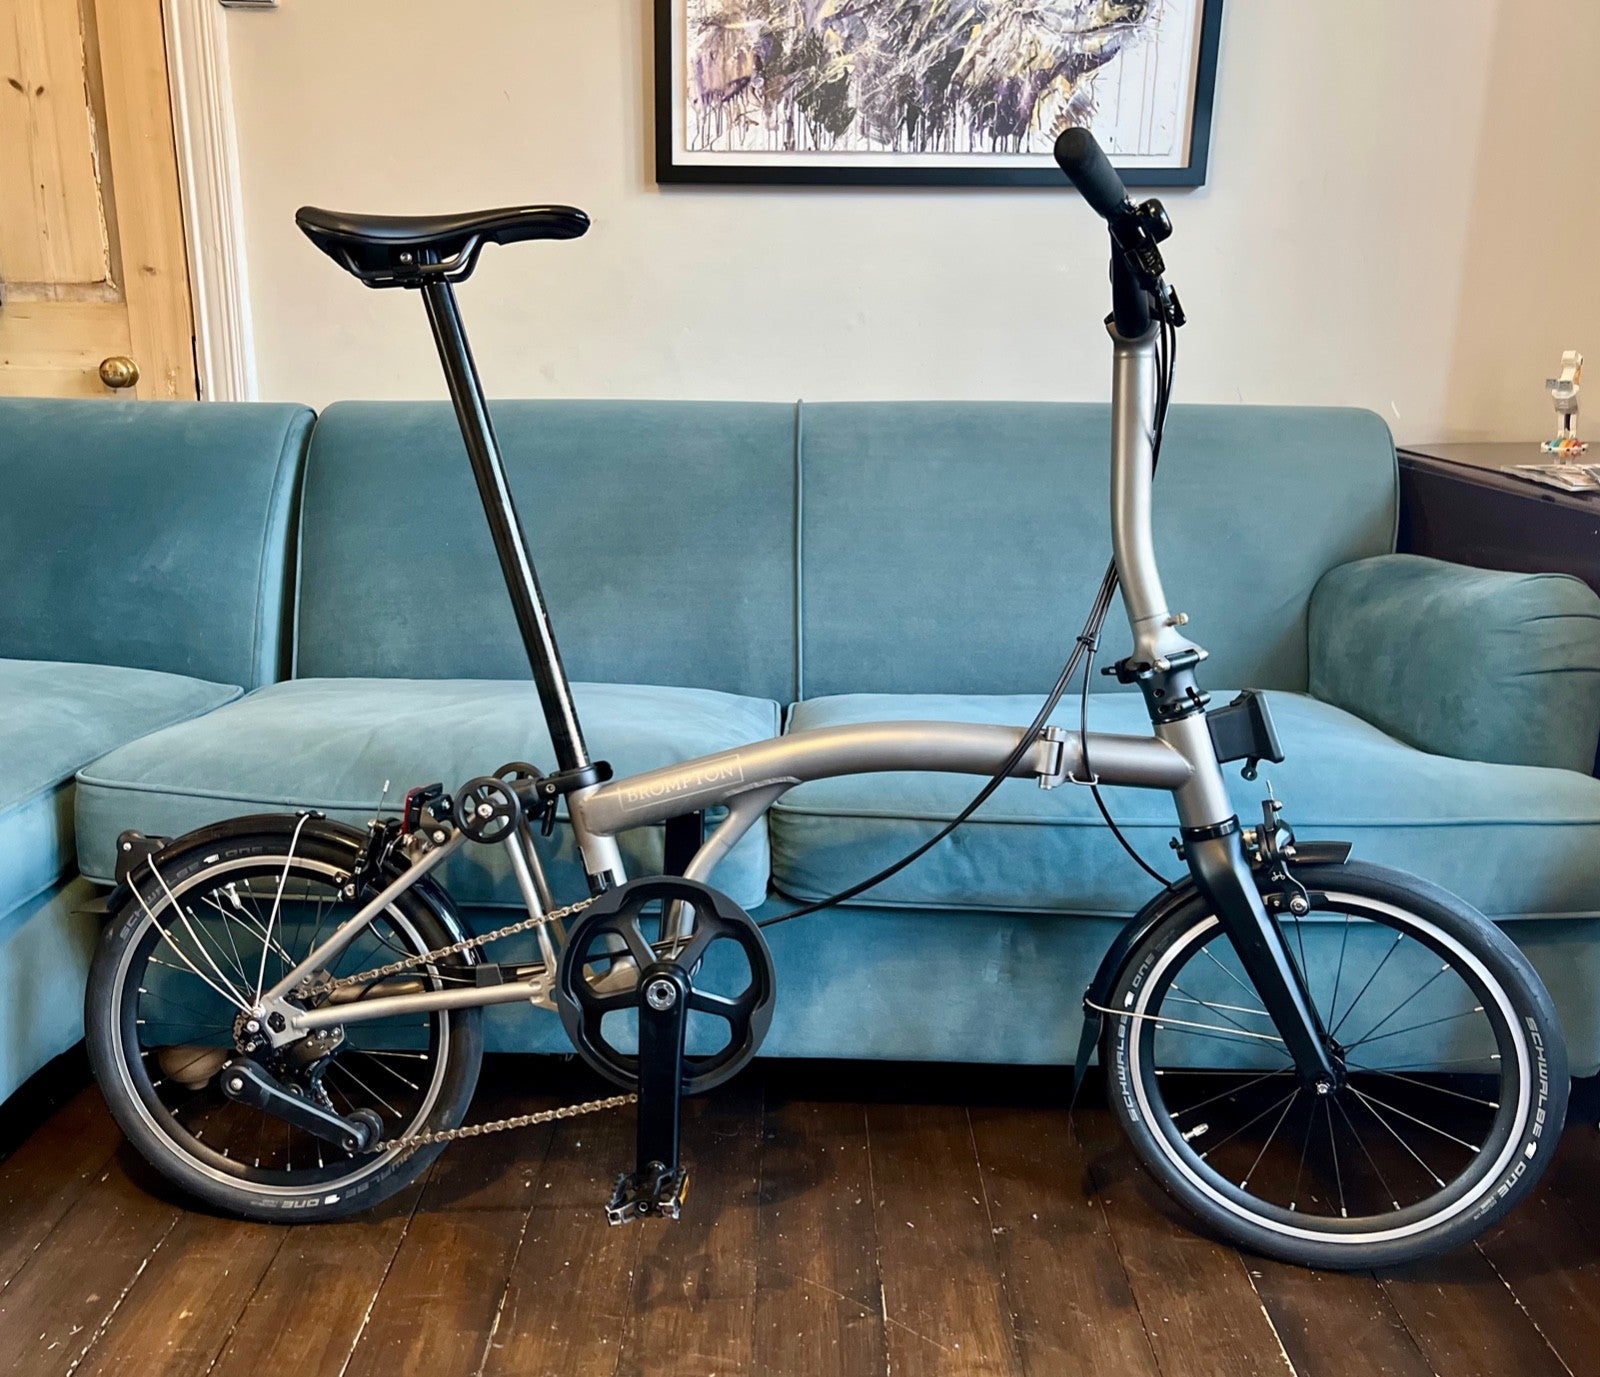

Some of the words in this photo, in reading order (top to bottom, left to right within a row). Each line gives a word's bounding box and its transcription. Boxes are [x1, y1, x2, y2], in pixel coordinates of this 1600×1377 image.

[628, 764, 734, 802] BROMPTON
[1116, 1014, 1139, 1122] SCHWALBE
[1132, 953, 1155, 988] ONE
[1525, 1016, 1549, 1138] SCHWALBE
[1497, 1161, 1527, 1198] ONE
[281, 1198, 320, 1209] ONE
